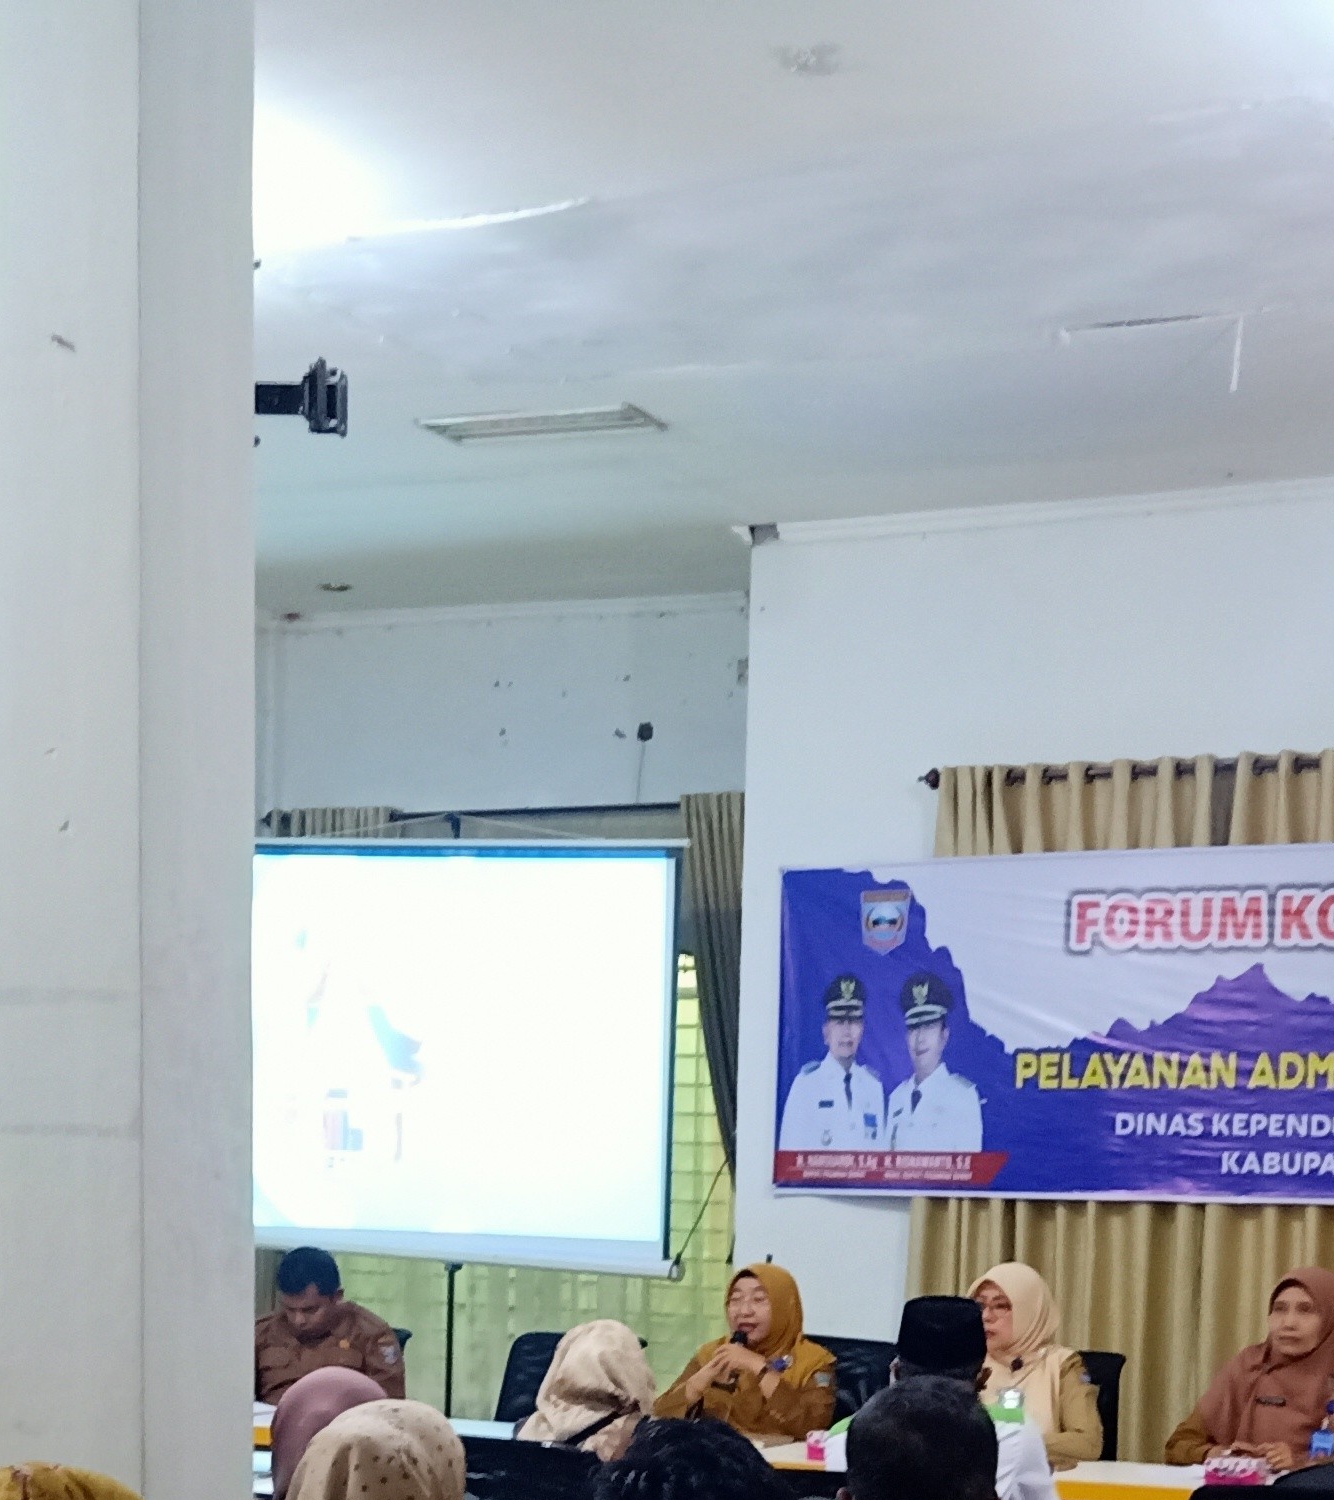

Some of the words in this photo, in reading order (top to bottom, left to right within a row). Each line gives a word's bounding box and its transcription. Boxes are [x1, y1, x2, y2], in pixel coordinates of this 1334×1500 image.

[1073, 893, 1265, 945] FORUM
[1013, 1051, 1238, 1091] PELAYANAN
[1114, 1112, 1205, 1137] DINAS
